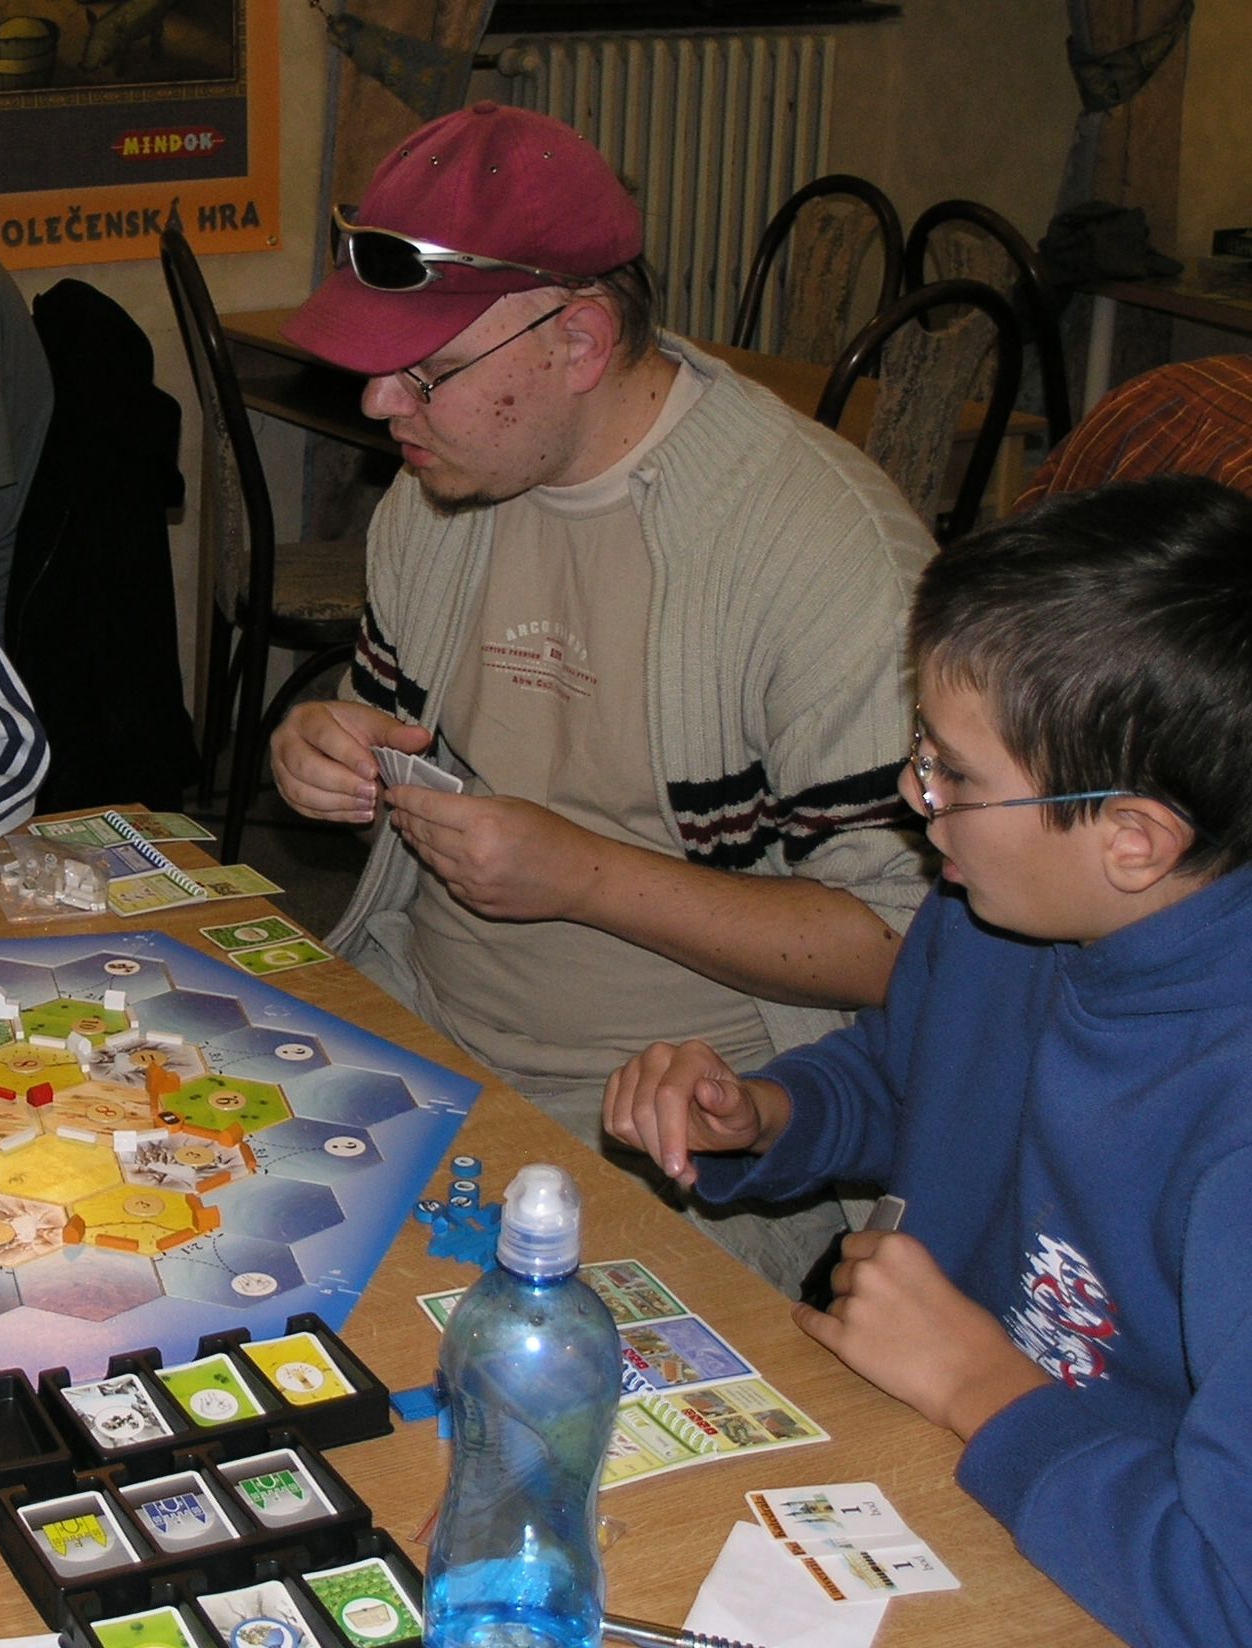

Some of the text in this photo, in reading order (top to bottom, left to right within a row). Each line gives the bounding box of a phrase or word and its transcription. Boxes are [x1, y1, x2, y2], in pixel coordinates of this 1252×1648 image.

[123, 132, 213, 155] MINDOK
[198, 200, 261, 232] HRA
[94, 1105, 117, 1117] 8
